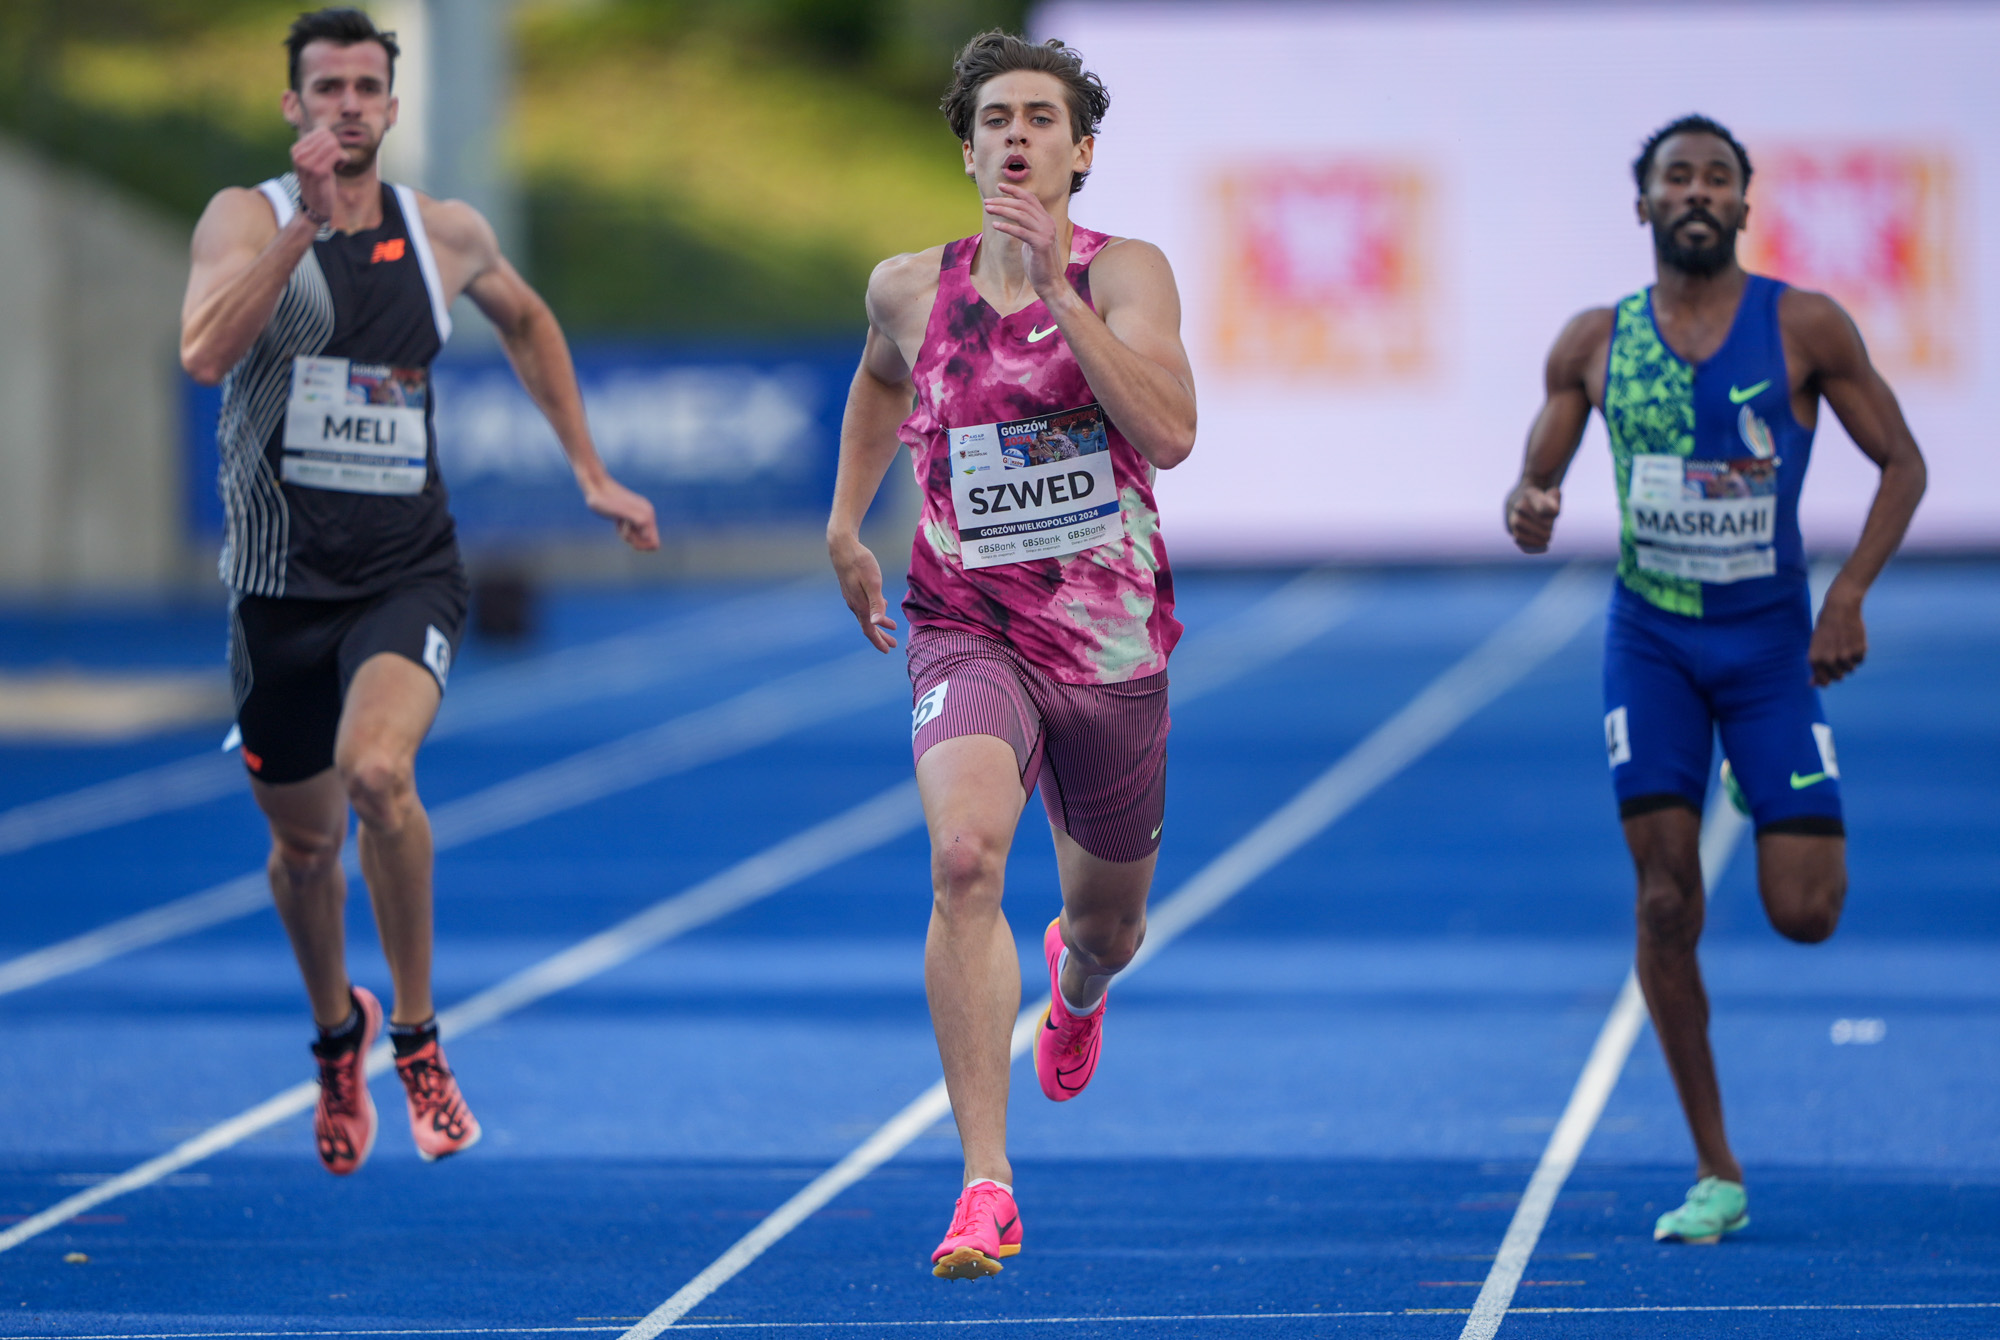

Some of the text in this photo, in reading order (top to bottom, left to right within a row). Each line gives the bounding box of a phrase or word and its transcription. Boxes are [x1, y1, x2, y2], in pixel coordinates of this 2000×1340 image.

[323, 414, 396, 445] MELI
[1001, 420, 1048, 436] GORZÓW
[1004, 434, 1032, 447] 2024
[968, 470, 1095, 515] SZWED
[980, 509, 1099, 537] GORZÓW WIELKOPOLSKI 2024
[1636, 508, 1768, 536] MASRAHI
[978, 541, 1016, 554] GBSBank
[1022, 535, 1061, 548] GBSBank
[1067, 524, 1106, 540] GBSBank
[914, 690, 936, 732] 5
